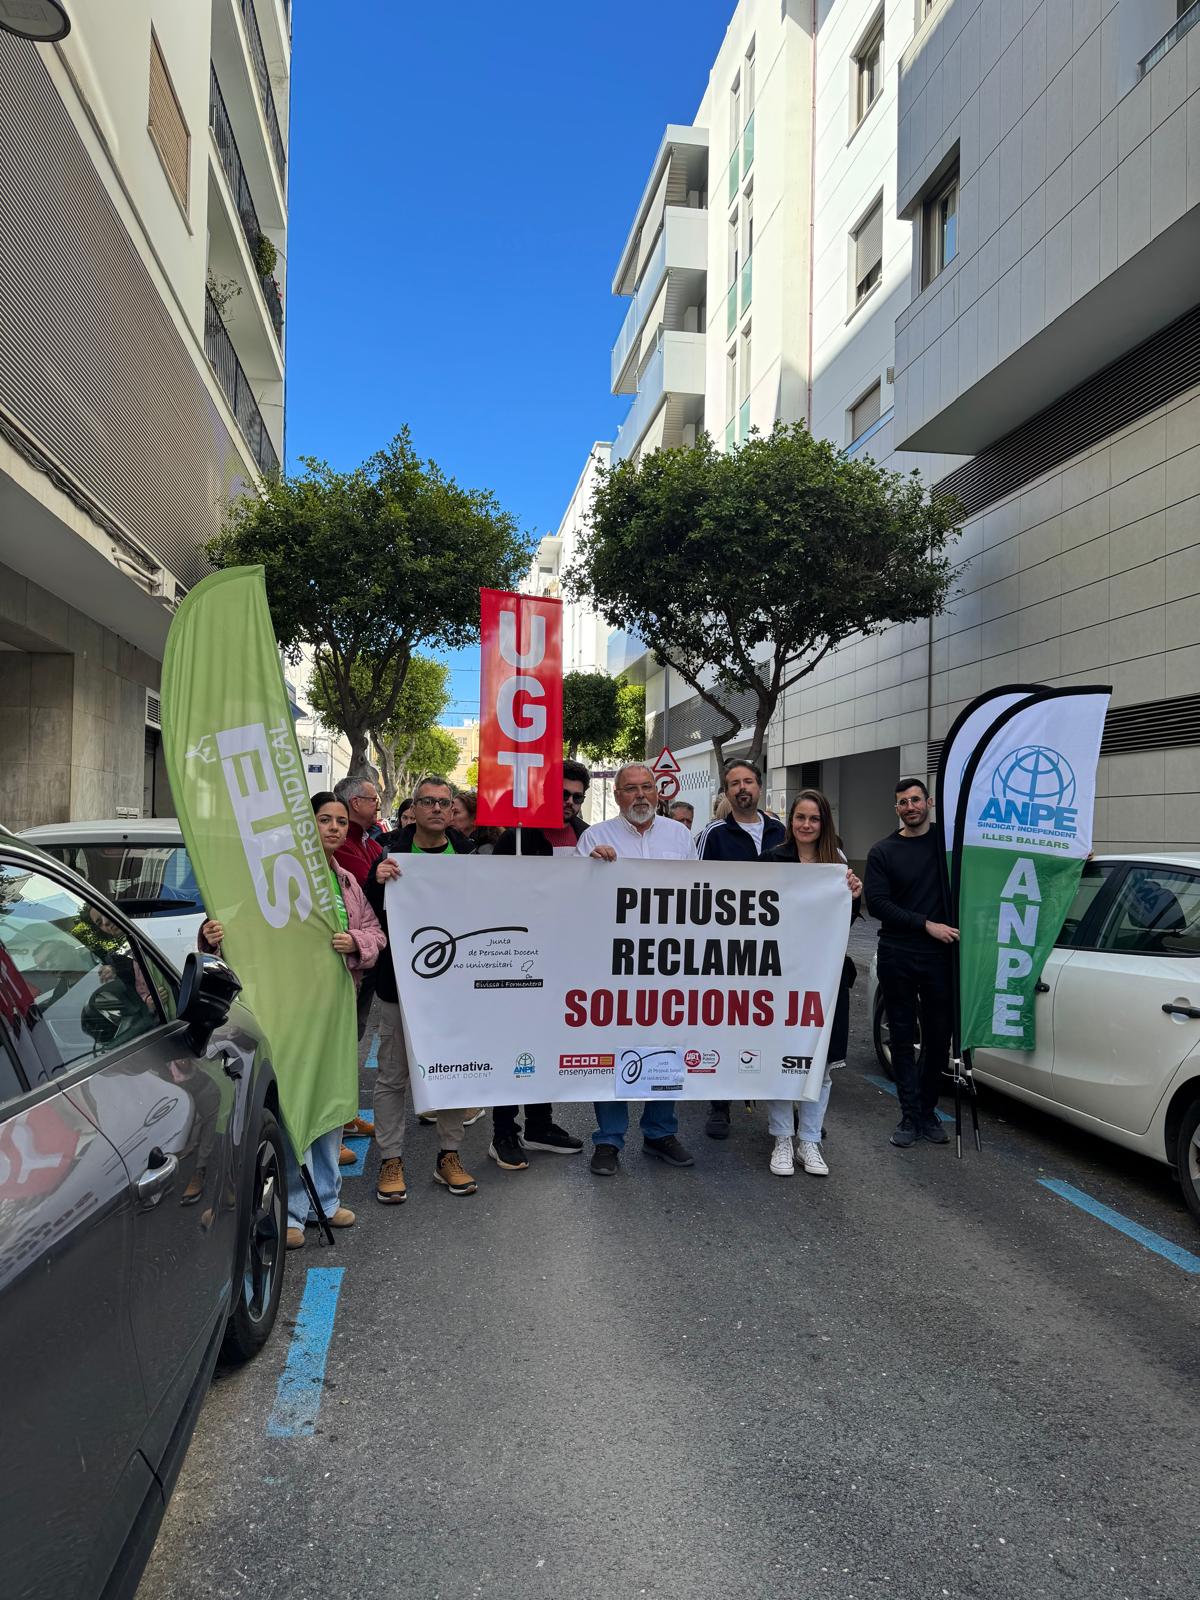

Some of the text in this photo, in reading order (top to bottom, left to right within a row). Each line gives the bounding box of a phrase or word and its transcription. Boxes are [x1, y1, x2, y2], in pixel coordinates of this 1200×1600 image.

[496, 611, 547, 808] UGT
[215, 722, 313, 929] STEI
[269, 718, 333, 912] INTERSINDICAL
[977, 821, 1077, 839] SINDICAT INDEPENDENT
[978, 797, 1078, 833] ANPE
[982, 833, 1070, 850] ILLES BALEARS
[615, 882, 780, 926] PITIÜSES
[486, 938, 511, 946] Junta
[611, 938, 782, 976] RECLAMA
[991, 857, 1042, 1037] ANPE
[564, 988, 825, 1028] SOLUCIONS JA
[428, 1061, 493, 1073] alternativa.
[514, 1066, 535, 1074] ANPE
[558, 1067, 615, 1077] ensenyament
[563, 1056, 599, 1066] CCOO
